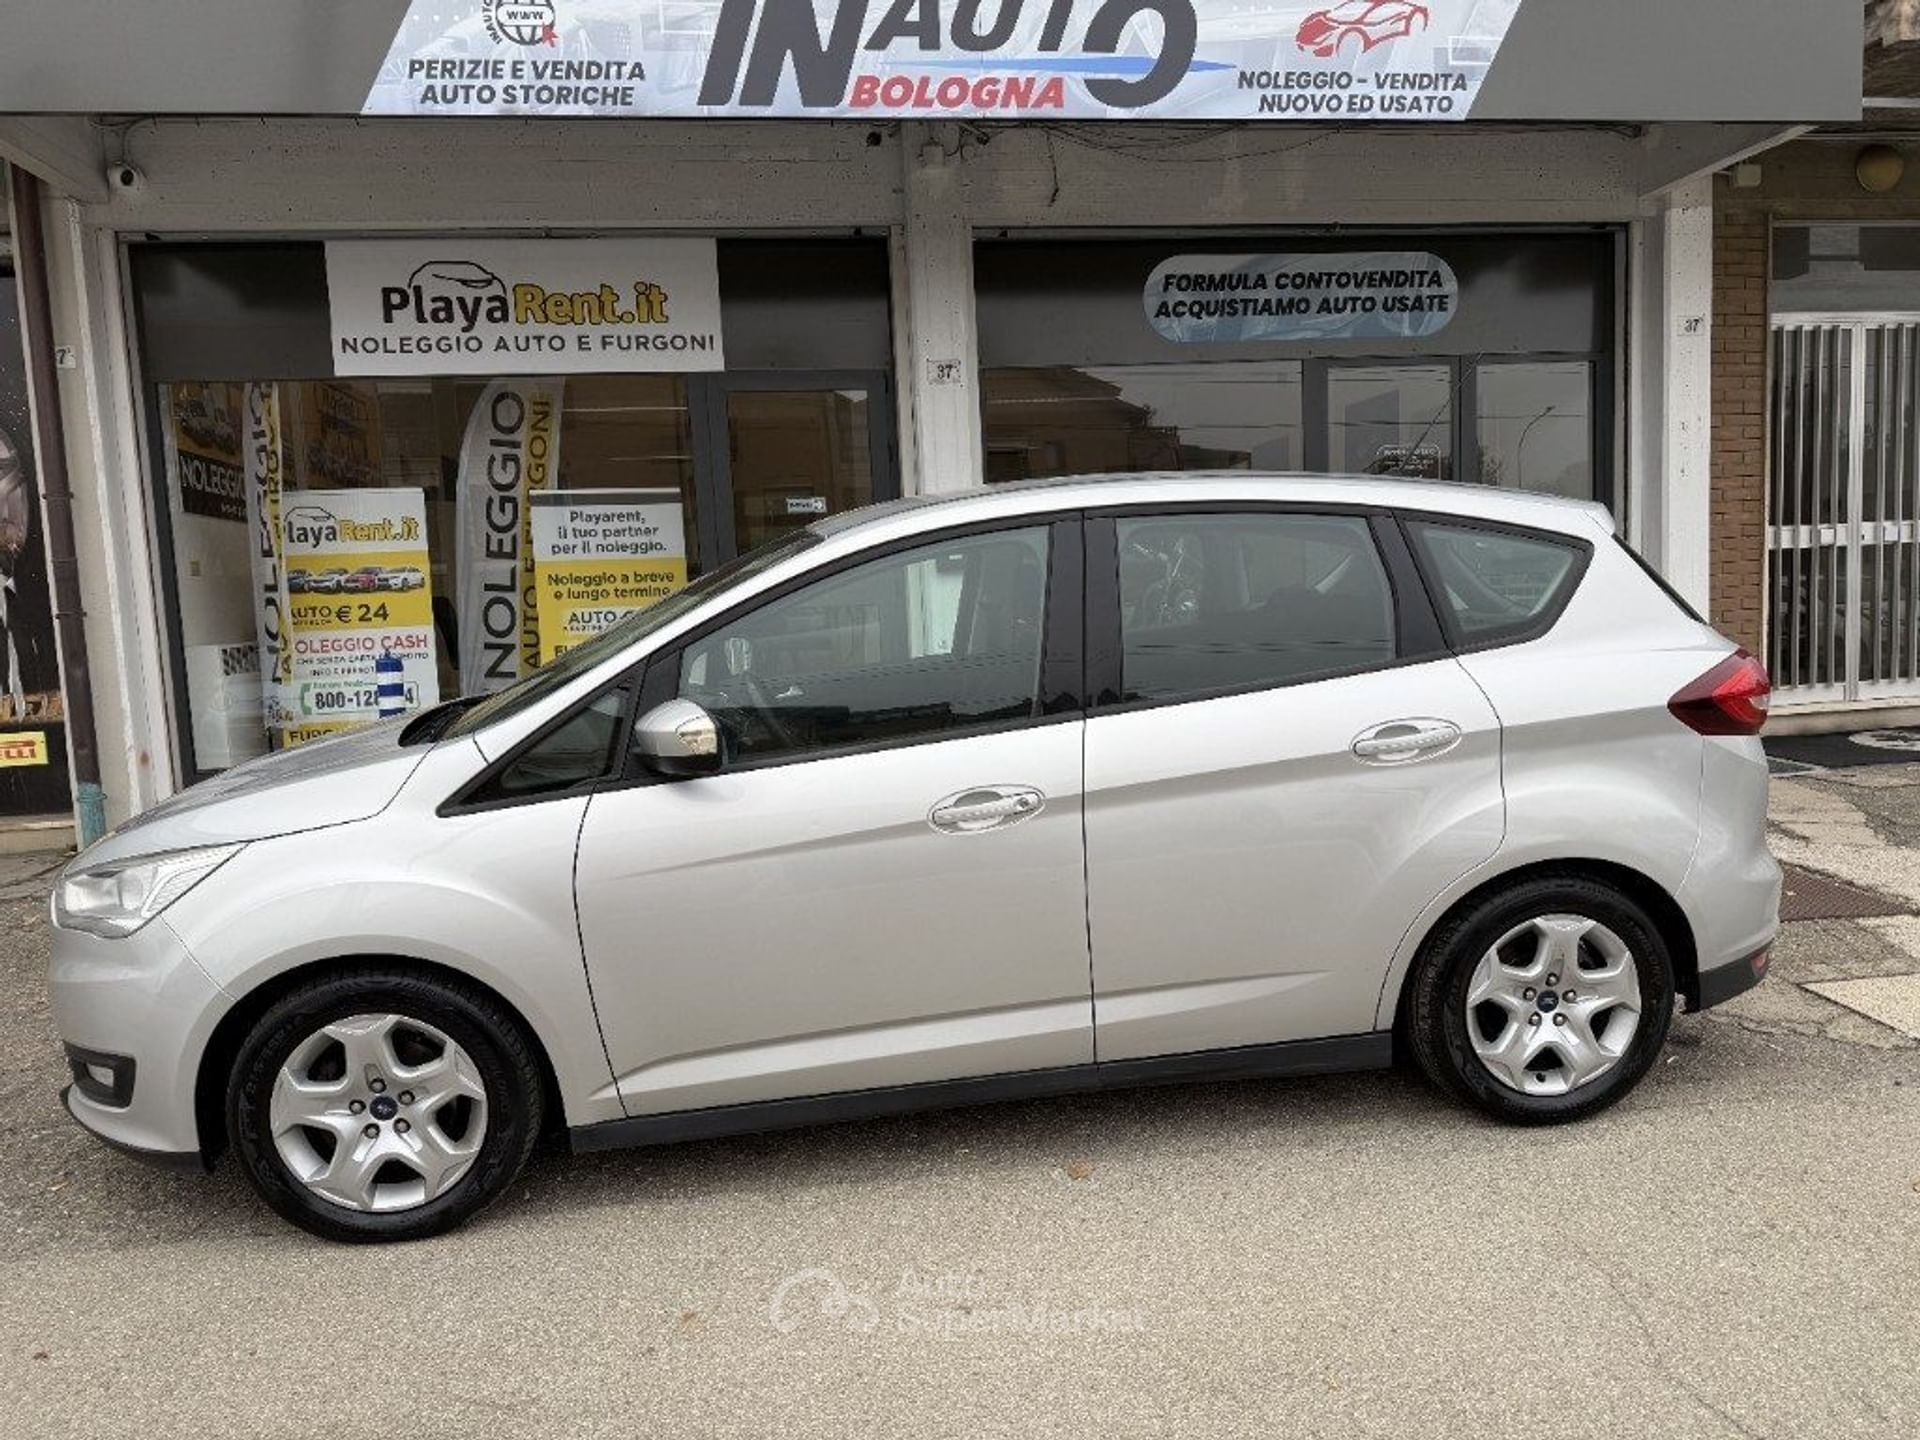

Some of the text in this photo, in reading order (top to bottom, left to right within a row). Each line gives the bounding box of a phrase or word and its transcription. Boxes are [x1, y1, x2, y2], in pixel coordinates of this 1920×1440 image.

[408, 59, 646, 81] PERIZIE E VENDITA
[1238, 71, 1353, 90] NOLEGGIO
[1374, 72, 1468, 91] VENDITA
[420, 84, 635, 106] AUTO STORICHE
[849, 75, 1065, 109] BOLOGNA
[1258, 94, 1454, 114] NUOVO ED USATO
[1163, 270, 1443, 293] FORMULA CONTOVENDITA
[381, 281, 669, 333] PlayaRent.it
[1154, 294, 1450, 320] ACQUISTIAMO AUTO USATE
[341, 333, 715, 355] NOLEGGIO AUTO E FURGONI
[525, 400, 550, 546] FGONI
[570, 510, 646, 525] Playarent,
[283, 515, 420, 548] layaRent.it
[482, 391, 525, 680] NOLEGGIO
[558, 525, 659, 540] il tuo partner
[551, 541, 668, 555] per il noleggio.
[547, 571, 675, 588] Noleggio a breve
[553, 585, 671, 601] e lungo termine
[336, 604, 352, 624] €
[357, 602, 389, 622] 24
[568, 610, 617, 625] AUTO
[523, 585, 541, 669] AUTO
[295, 637, 376, 655] OLEGGIO
[381, 634, 428, 651] CASH
